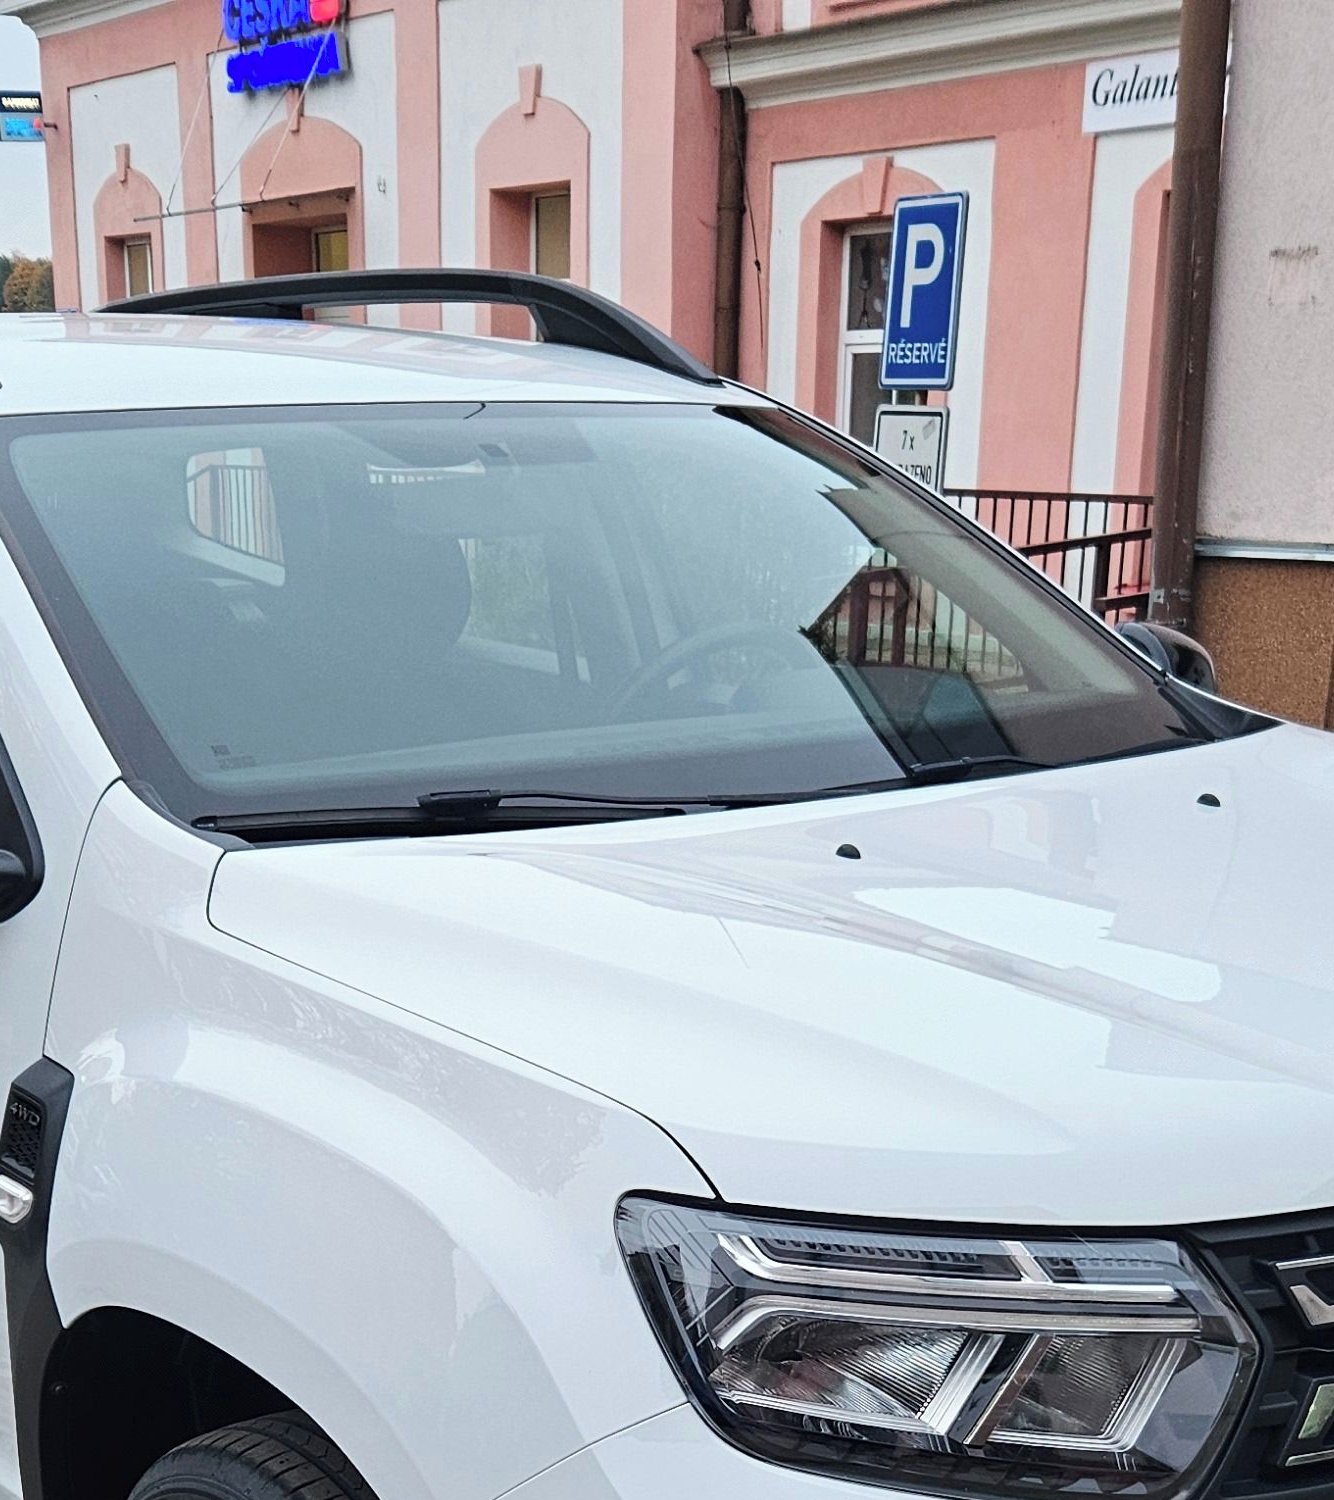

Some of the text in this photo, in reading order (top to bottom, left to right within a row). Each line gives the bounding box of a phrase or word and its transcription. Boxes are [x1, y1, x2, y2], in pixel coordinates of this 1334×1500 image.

[900, 223, 945, 328] P
[887, 338, 947, 364] RÉSERVÉ
[10, 1102, 40, 1126] 4WD
